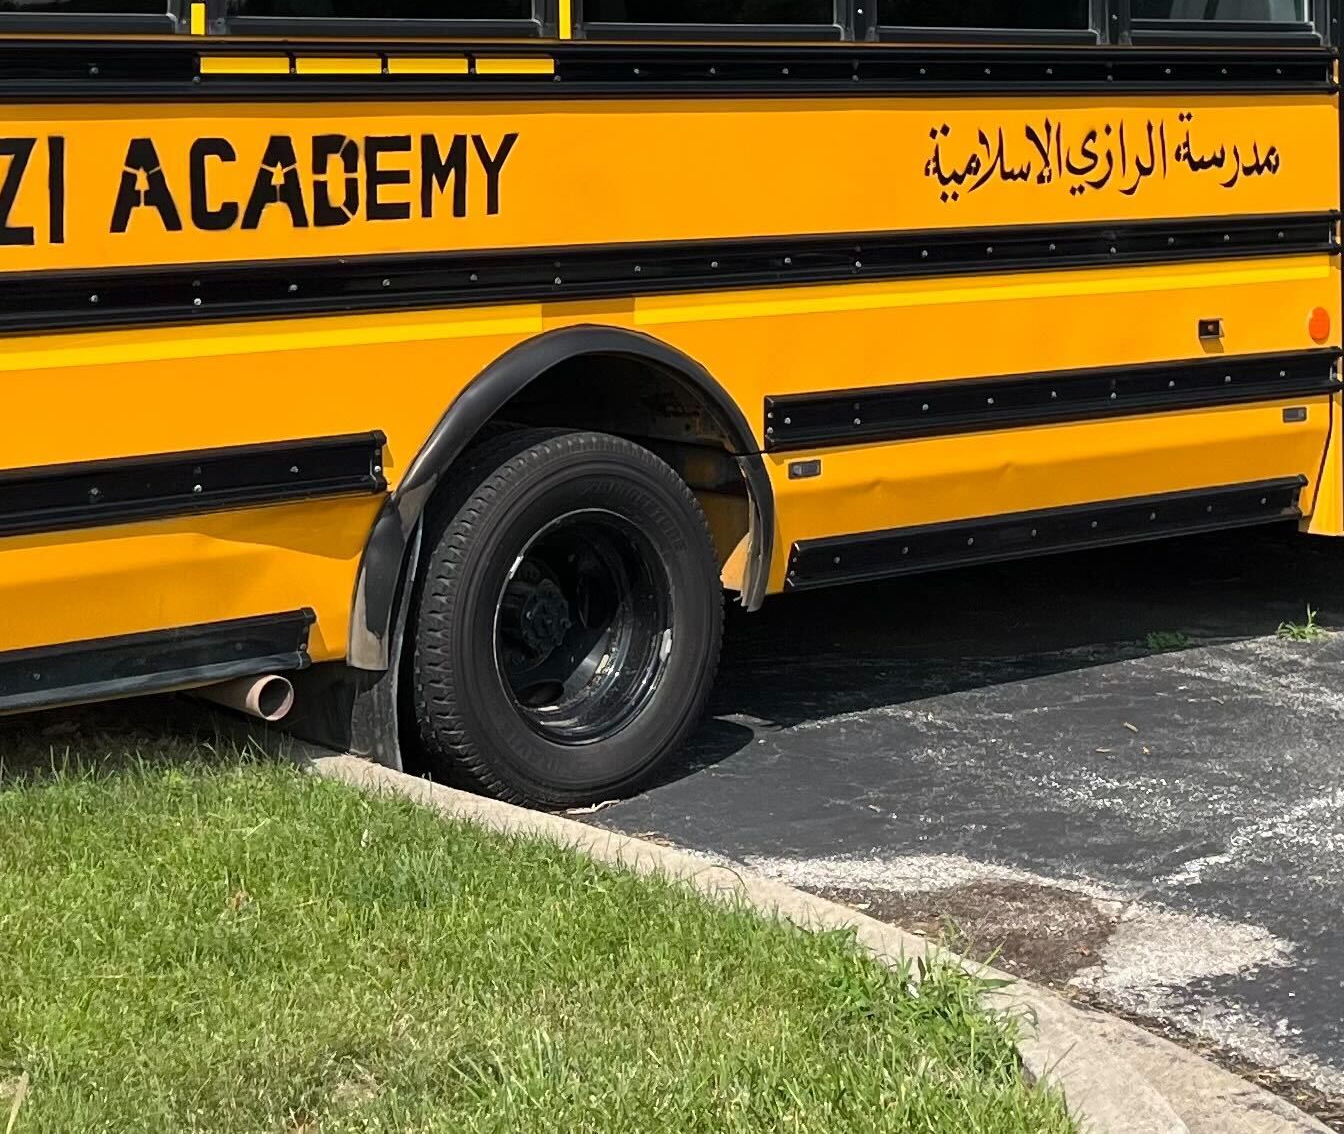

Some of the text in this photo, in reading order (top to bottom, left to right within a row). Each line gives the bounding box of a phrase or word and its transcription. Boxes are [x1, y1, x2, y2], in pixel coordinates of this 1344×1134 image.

[109, 132, 520, 234] ACADEMY
[1065, 118, 1167, 197] الرازي
[1174, 112, 1280, 188] مدرسة
